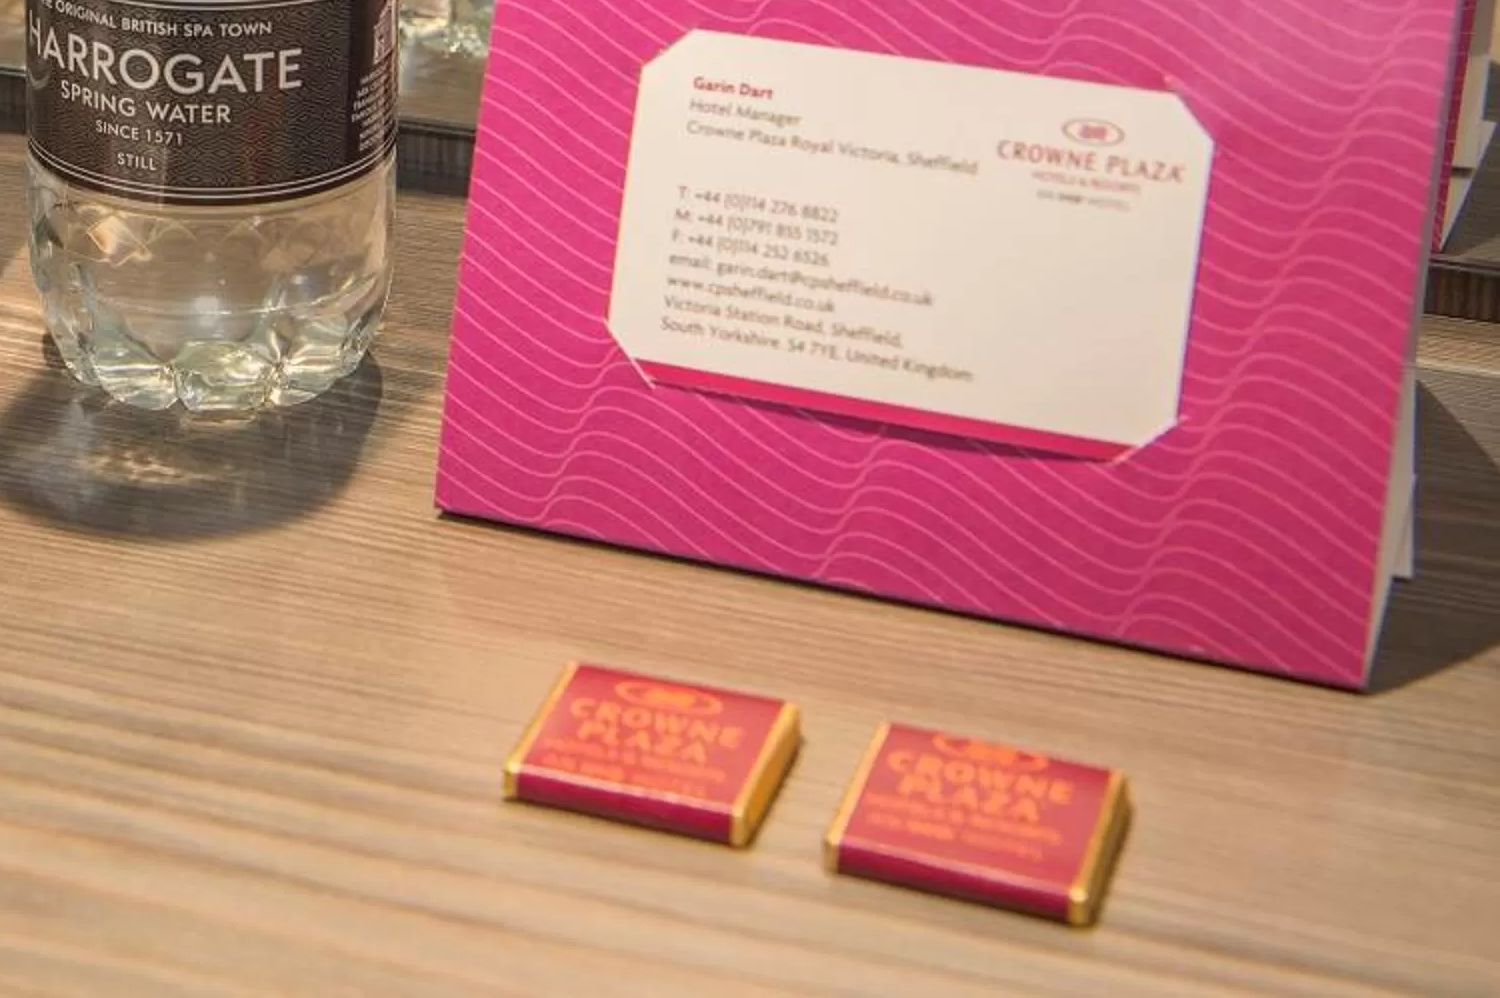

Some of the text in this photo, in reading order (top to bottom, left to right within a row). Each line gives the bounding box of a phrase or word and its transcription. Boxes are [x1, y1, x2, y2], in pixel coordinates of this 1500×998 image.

[121, 16, 178, 37] BRITISH
[183, 22, 214, 39] SPA
[219, 21, 273, 39] TOWN
[29, 9, 302, 95] HARROGATE
[60, 79, 232, 124] SPRING WATER
[689, 98, 803, 128] Hotel Manager
[95, 120, 183, 146] SINCE 1571
[117, 152, 157, 171] STILL
[996, 139, 1098, 171] CROWNE
[1104, 154, 1185, 184] PLAZA
[570, 697, 746, 749] CROWNE
[577, 718, 707, 766] PLAZA
[886, 749, 1075, 806] CROWNE
[897, 773, 1040, 824] PLAZA
